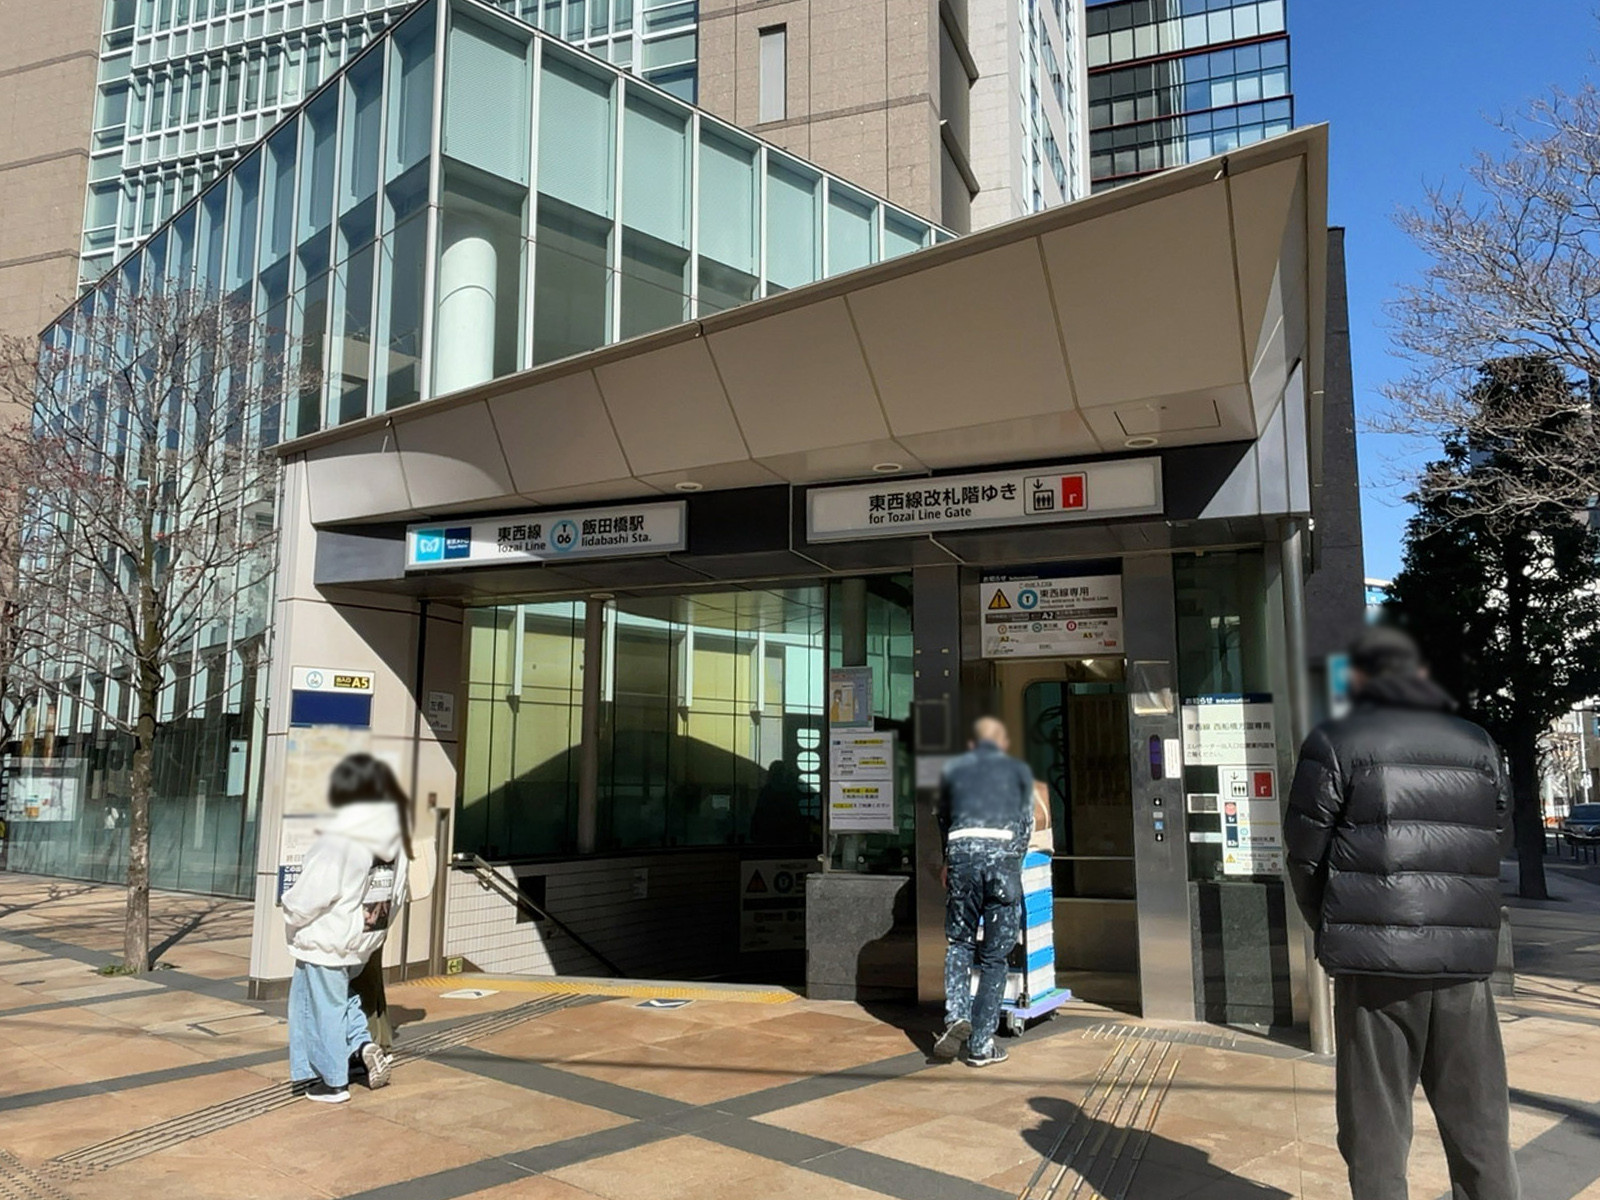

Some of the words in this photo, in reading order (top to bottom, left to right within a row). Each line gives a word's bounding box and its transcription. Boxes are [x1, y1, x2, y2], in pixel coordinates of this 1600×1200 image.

[868, 483, 1017, 512] 東西線改札階ゆき
[869, 512, 885, 524] for
[887, 509, 916, 522] Tozai
[918, 508, 941, 520] Line
[945, 506, 972, 518] Gate
[562, 524, 567, 533] T
[582, 515, 645, 535] 飯田橋駅
[497, 524, 542, 543] 東西線
[557, 535, 571, 544] 06
[581, 533, 629, 547] Iidabashi
[632, 532, 652, 543] Sta.
[497, 542, 523, 553] Tozai
[525, 541, 546, 551] Line
[351, 677, 369, 688] A5
